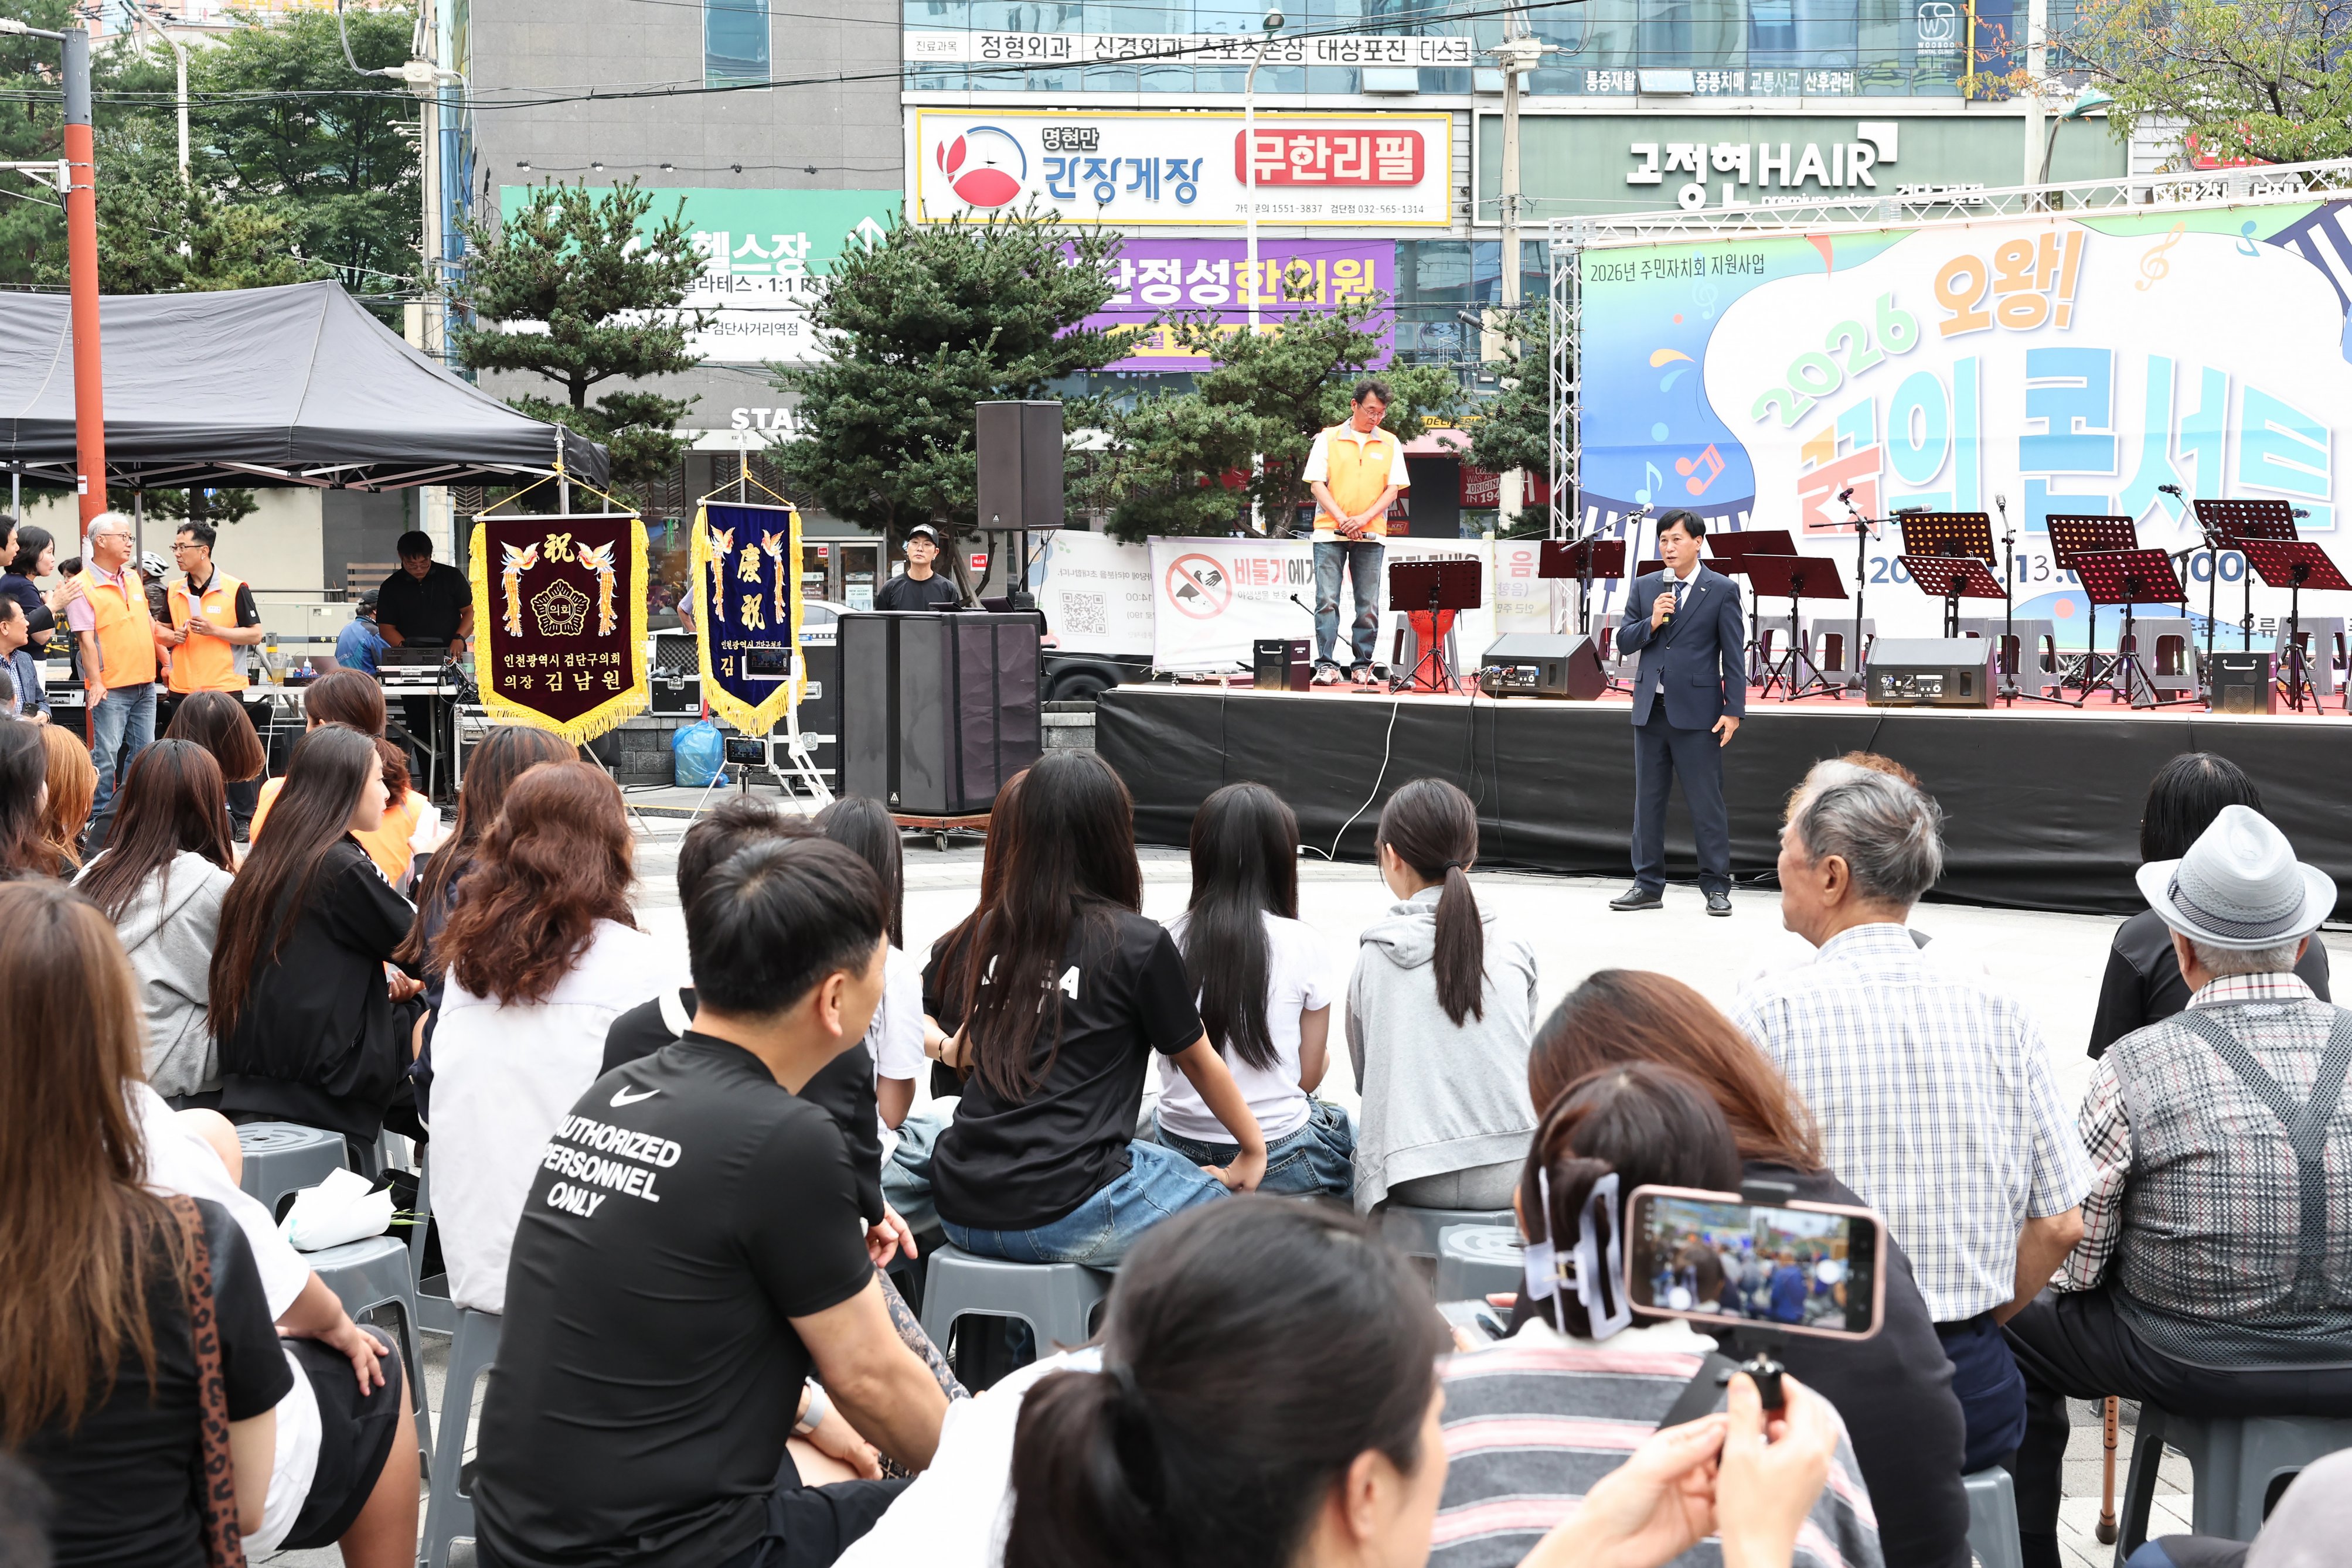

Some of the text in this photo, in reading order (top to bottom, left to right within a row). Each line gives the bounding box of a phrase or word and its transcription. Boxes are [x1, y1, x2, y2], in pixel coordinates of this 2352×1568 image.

[916, 40, 957, 52] 진료과목
[981, 36, 1072, 59] 정형외과
[1094, 36, 1184, 60] 신경외과
[1318, 39, 1406, 62] 대상포진
[1421, 40, 1469, 62] 디스크
[1586, 70, 1636, 91] 통증재활
[1696, 71, 1745, 92] 중풍치매
[1750, 71, 1799, 92] 교통사고
[1805, 71, 1853, 92] 산후관리
[1043, 128, 1100, 151] 명현만
[1254, 134, 1413, 181] 무한리필
[1043, 156, 1203, 204] 간장게장
[1272, 204, 1322, 213] 1551-3837
[1330, 204, 1355, 214] 검단점
[1358, 204, 1424, 213] 032-565-1314
[691, 230, 811, 276] 헬스장
[1591, 254, 1764, 282] 2026년 주민자치회 지원사업
[768, 278, 792, 292] 1:1
[713, 322, 798, 336] 검단사거리역점
[1751, 230, 2084, 428] 2026 오왕!
[2019, 347, 2336, 535] 콘서트
[1471, 478, 1500, 493] ORIGIN
[544, 533, 575, 563] 祝
[550, 604, 571, 616] 의회
[504, 652, 620, 667] 인천광역시 검단구의회
[504, 674, 534, 690] 의장
[547, 1182, 606, 1218] ONLY
